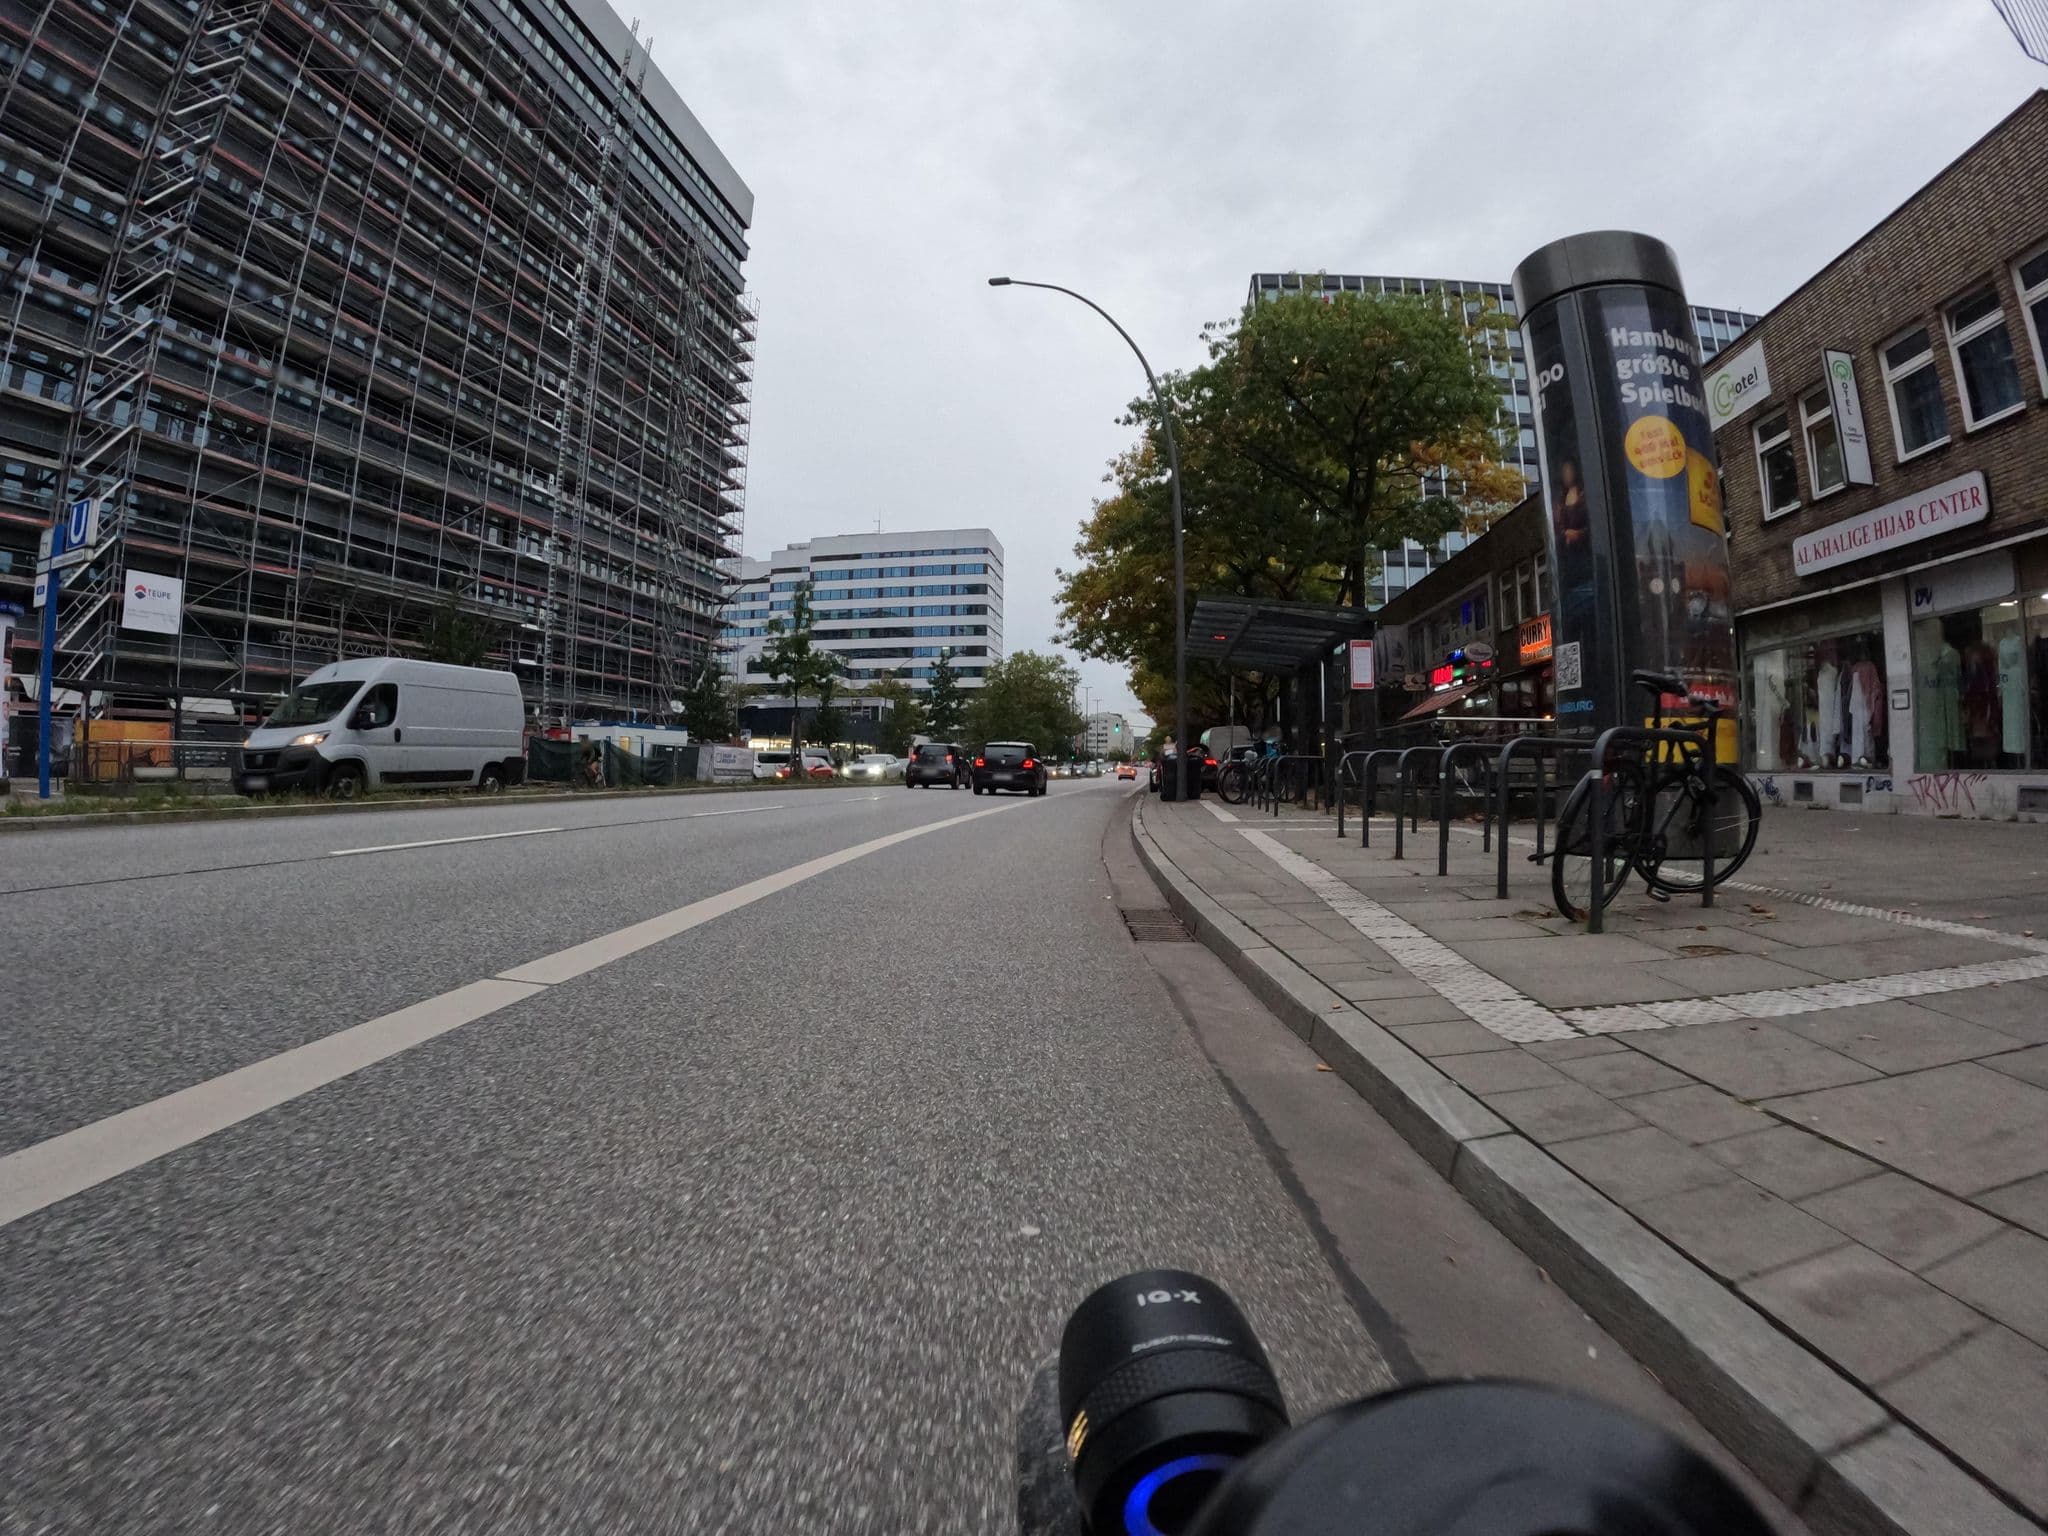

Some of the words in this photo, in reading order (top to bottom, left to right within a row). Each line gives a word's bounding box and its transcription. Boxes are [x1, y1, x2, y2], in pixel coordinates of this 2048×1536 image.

[1615, 352, 1690, 381] größte
[1620, 382, 1702, 411] Spielbu
[70, 503, 88, 544] U
[1796, 547, 1812, 566] AL
[1813, 525, 1871, 561] KHALIGE
[1874, 510, 1915, 541] HIJAB
[1919, 486, 1982, 525] CENTER
[148, 588, 172, 600] TEUPE
[1521, 620, 1548, 647] CURRY
